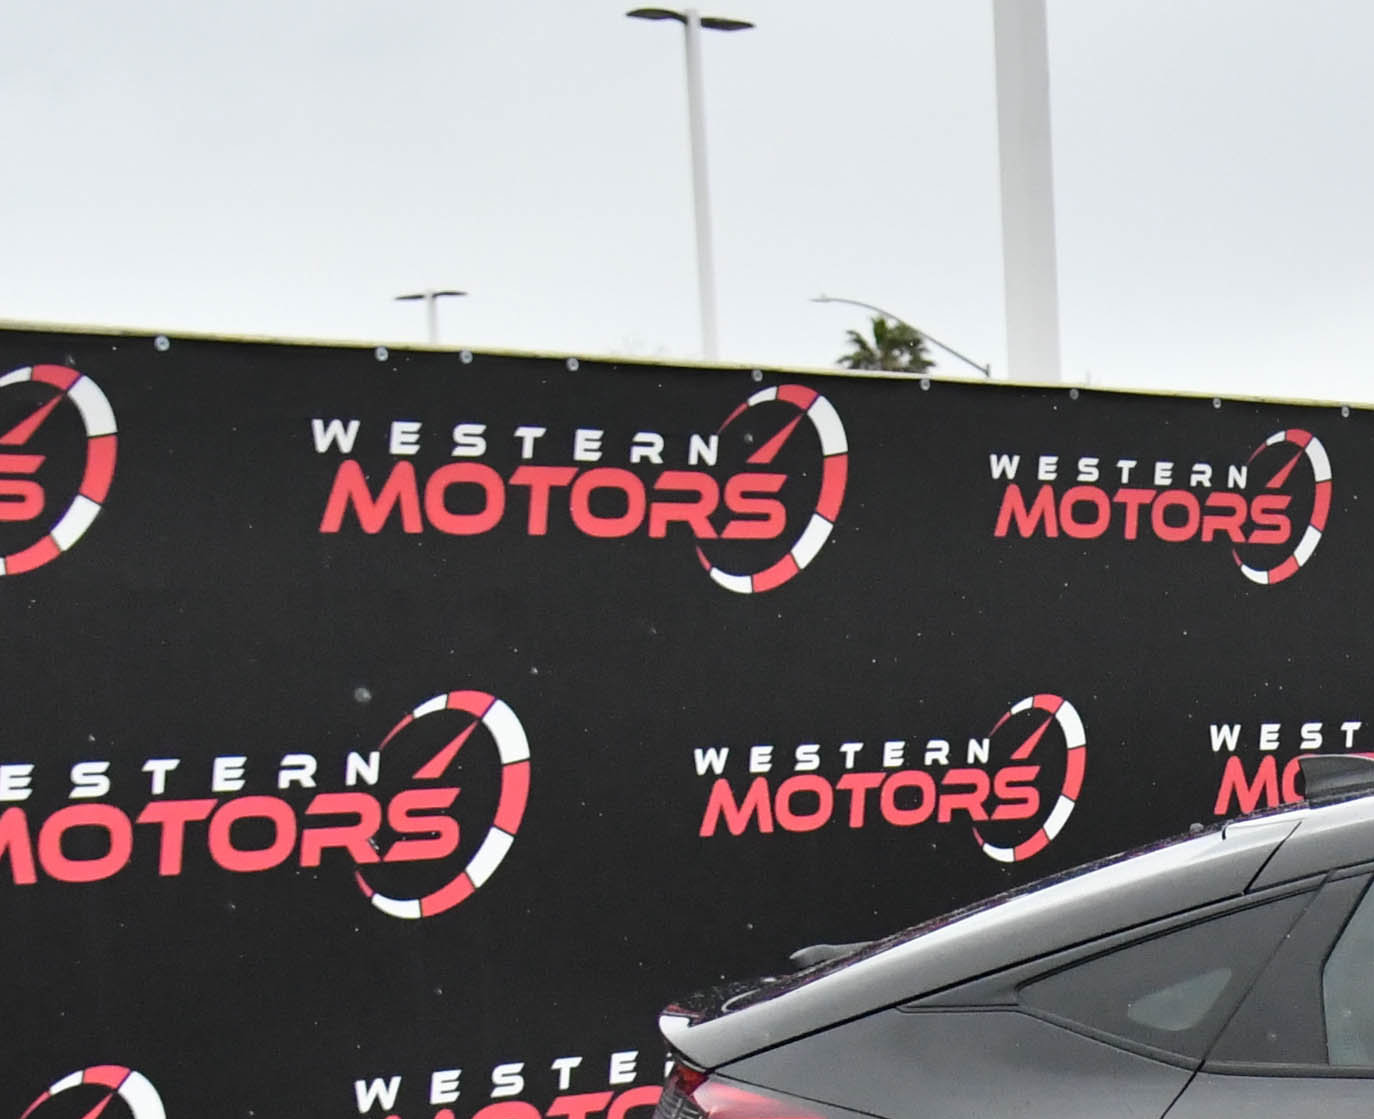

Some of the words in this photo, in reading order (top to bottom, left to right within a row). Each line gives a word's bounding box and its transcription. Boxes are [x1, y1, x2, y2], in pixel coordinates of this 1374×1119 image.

[312, 418, 719, 466] WESTERN
[319, 459, 788, 540] MOTORS
[989, 453, 1248, 490] WESTERN
[994, 483, 1292, 545] MOTORS
[0, 751, 381, 802] ESTERN
[693, 737, 990, 776] WESTERN
[699, 765, 1041, 838] MOTORS
[354, 1050, 675, 1114] WESTE
